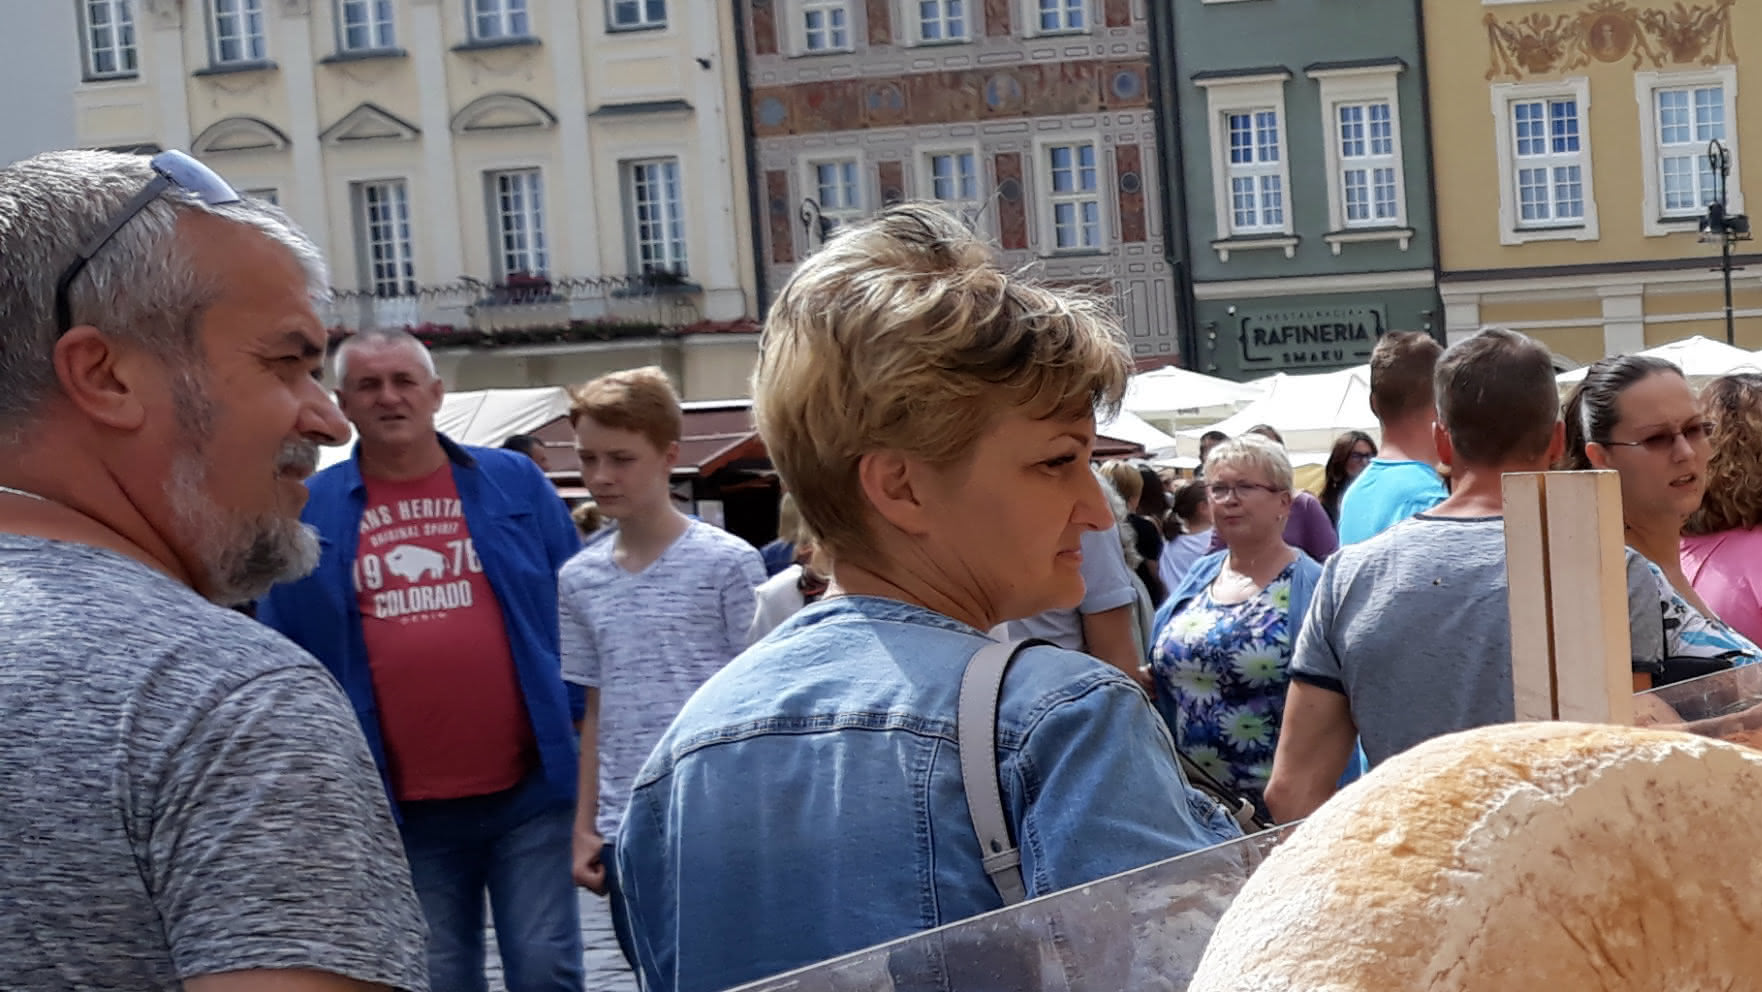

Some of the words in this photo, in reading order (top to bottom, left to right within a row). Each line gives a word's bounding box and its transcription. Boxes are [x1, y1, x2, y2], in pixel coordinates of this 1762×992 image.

[1253, 322, 1369, 346] RAFINERIA
[1282, 349, 1343, 363] SMAKU
[360, 505, 392, 534] ANS
[398, 498, 463, 520] HERITA
[373, 579, 474, 619] COLORADO
